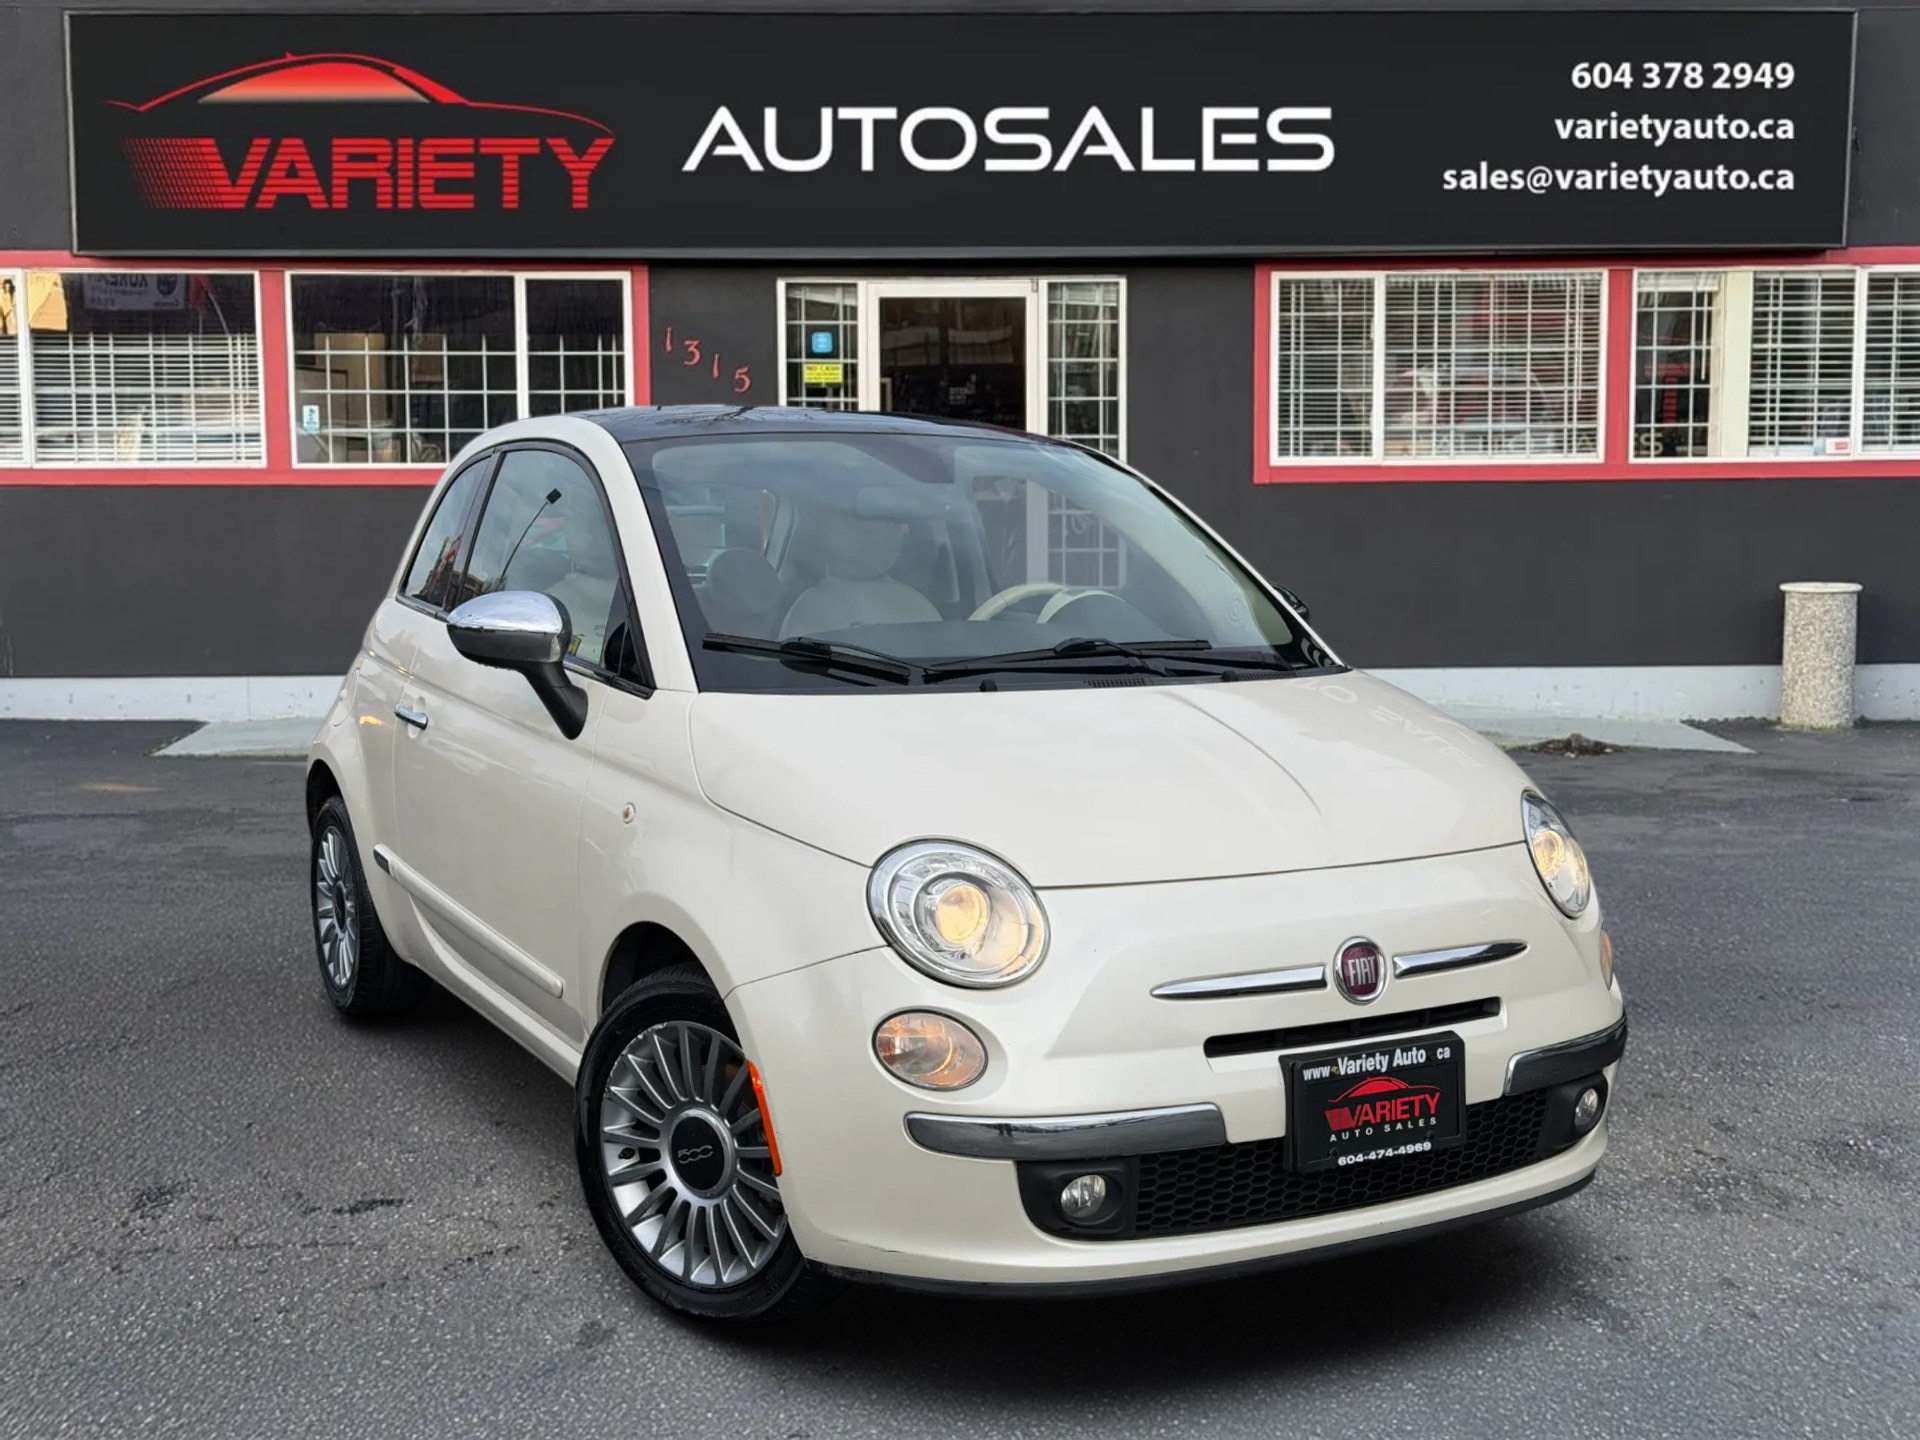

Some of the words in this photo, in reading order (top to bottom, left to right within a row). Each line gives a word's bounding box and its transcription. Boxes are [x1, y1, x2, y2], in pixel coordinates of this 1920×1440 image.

[1571, 61, 1633, 89] 604
[1642, 61, 1704, 89] 378
[1711, 61, 1795, 89] 2949
[681, 105, 1335, 172] AUTOSALES
[1554, 111, 1795, 147] varietyauto.ca
[140, 136, 615, 210] VARIETY
[1443, 160, 1795, 198] sales@varietyauto.ca
[1347, 955, 1377, 987] FIAT
[1337, 1052, 1389, 1076] Variety
[1392, 1046, 1426, 1066] Auto
[1325, 1092, 1442, 1131] VARIETY
[1329, 1127, 1373, 1142] AUTO
[1384, 1117, 1437, 1133] SALES
[1337, 1141, 1432, 1166] 604-474-4969
